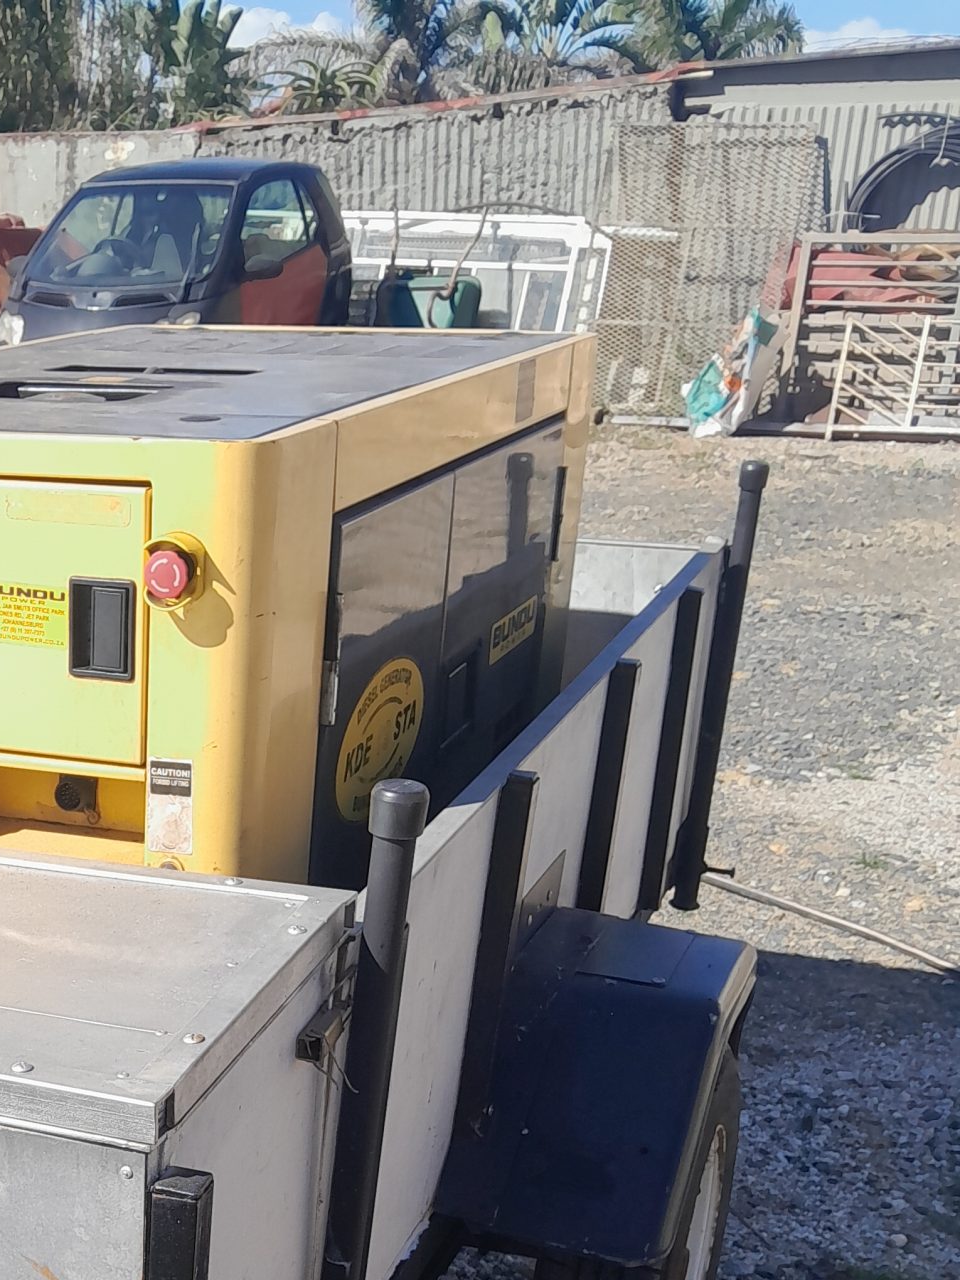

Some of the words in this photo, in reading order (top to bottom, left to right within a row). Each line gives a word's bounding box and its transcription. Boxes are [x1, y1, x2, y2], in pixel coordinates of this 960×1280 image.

[1, 596, 46, 605] POWER
[32, 606, 49, 614] OFFICE
[2, 618, 44, 628] JOHANNESBURG
[492, 601, 534, 649] BUNDU
[393, 699, 417, 741] STA
[344, 734, 374, 783] KDE
[151, 767, 191, 778] CAUTION!
[171, 779, 189, 788] LIFTING
